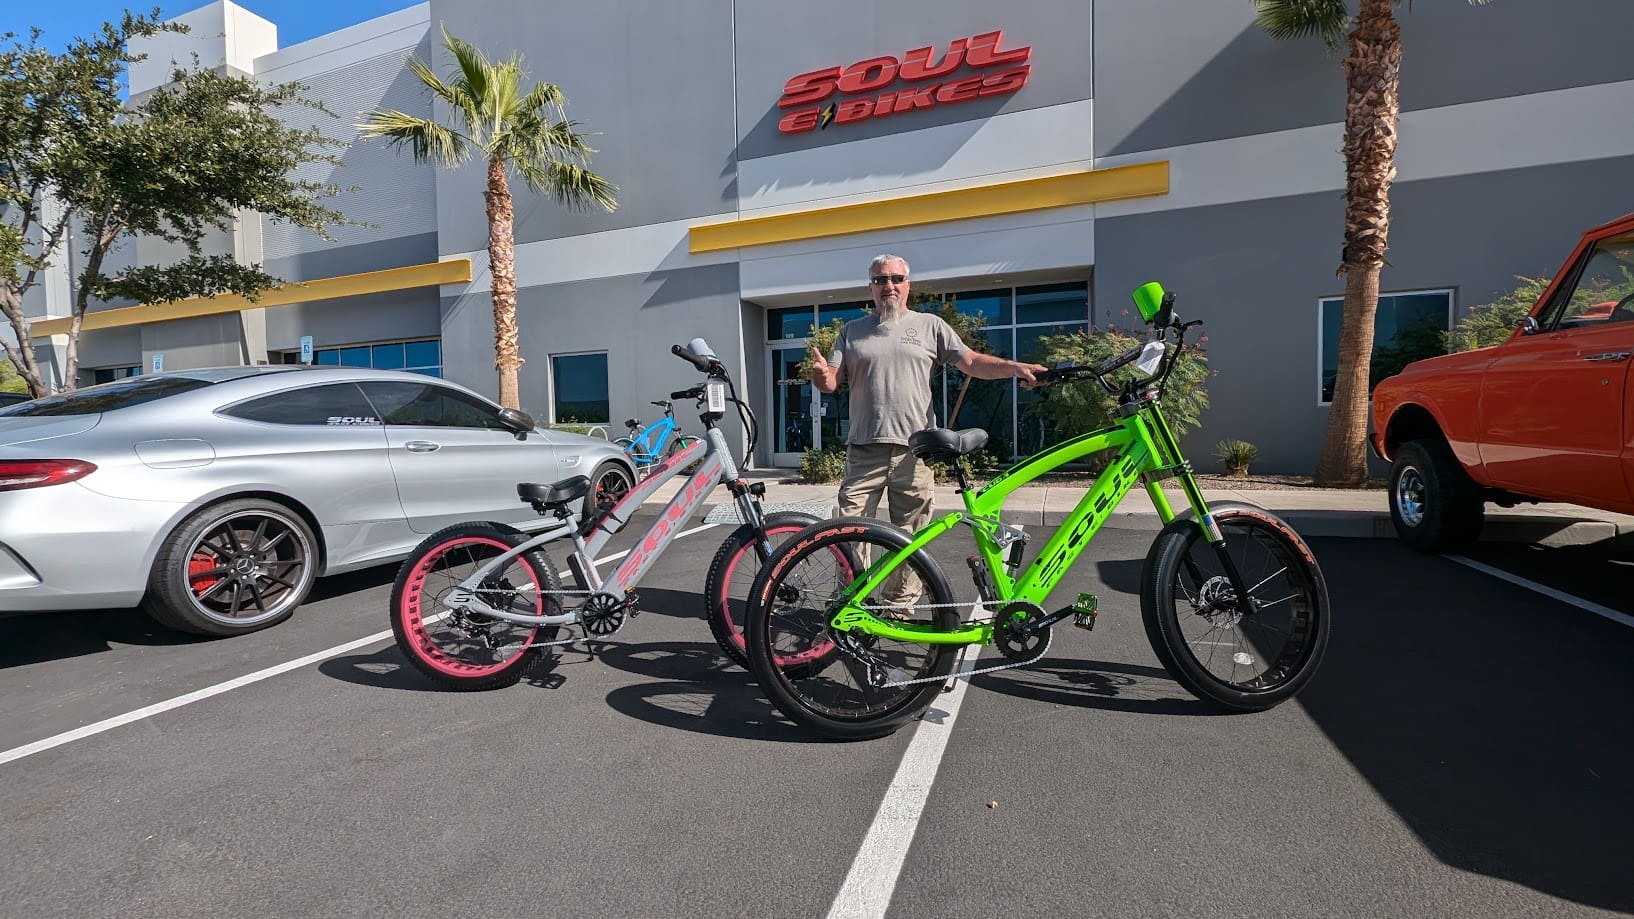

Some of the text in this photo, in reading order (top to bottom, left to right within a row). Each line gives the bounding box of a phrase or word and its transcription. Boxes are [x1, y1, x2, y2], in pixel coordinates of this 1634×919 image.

[778, 30, 1032, 108] SOUL
[834, 64, 1032, 124] BIKES
[327, 416, 380, 424] SOUL
[616, 463, 722, 587] SOUL
[1039, 449, 1150, 588] SOUL
